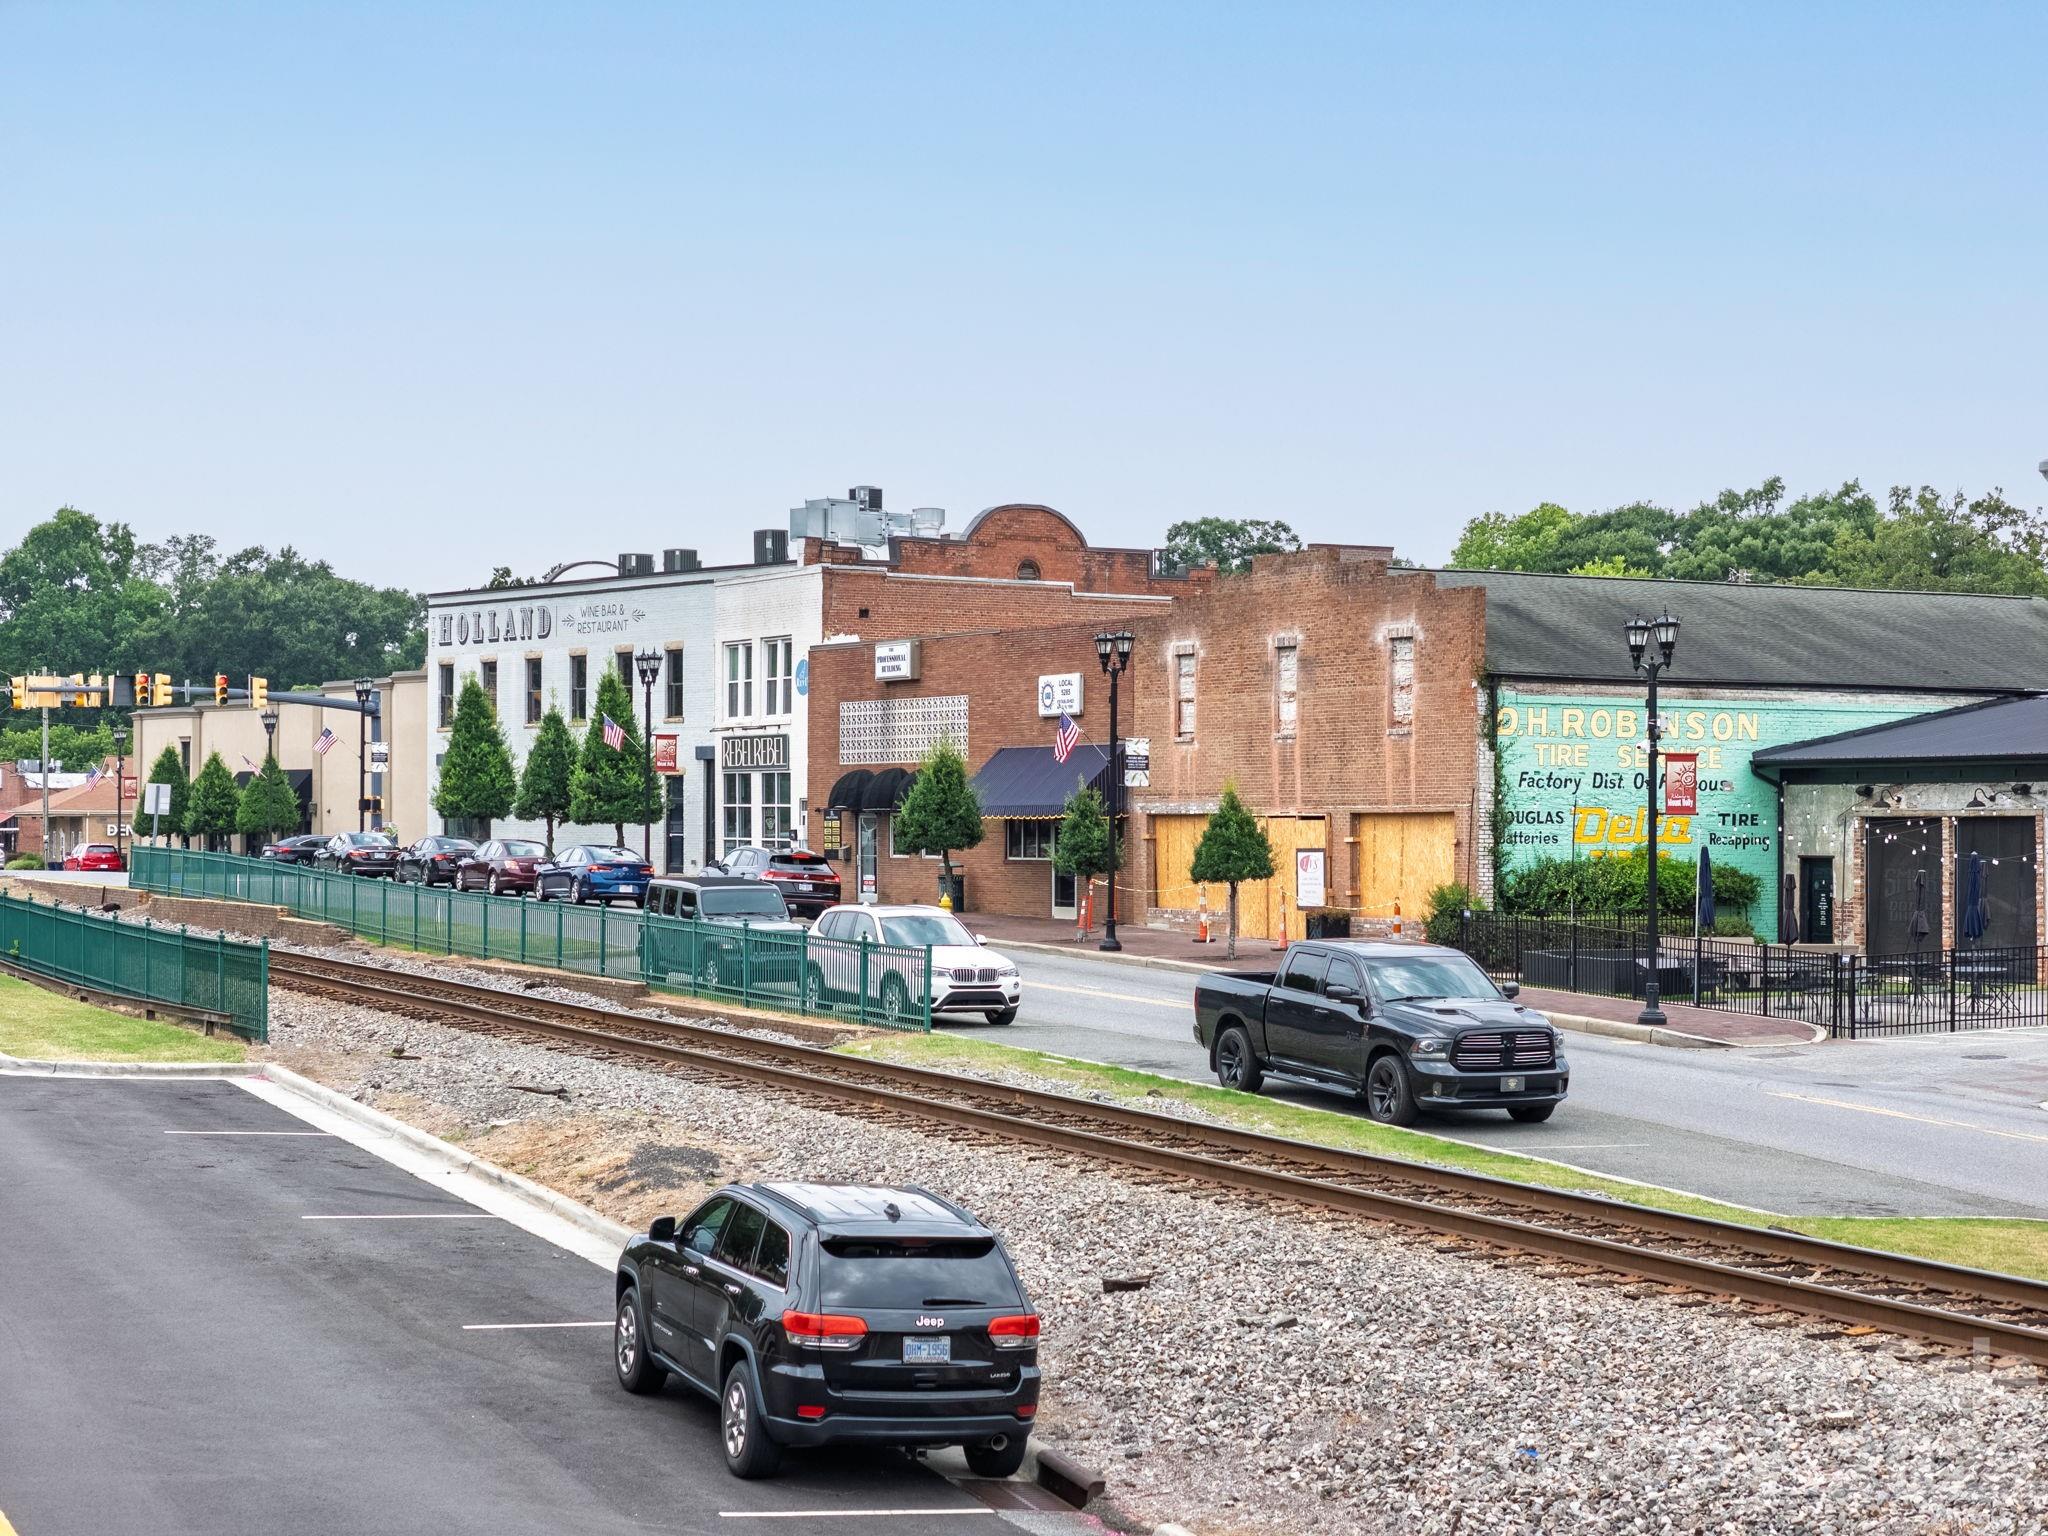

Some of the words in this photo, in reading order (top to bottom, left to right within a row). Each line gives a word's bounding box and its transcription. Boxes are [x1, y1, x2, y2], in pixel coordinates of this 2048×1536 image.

[580, 605, 600, 618] WINE
[601, 604, 617, 617] BAR
[619, 603, 624, 616] &
[438, 605, 552, 647] HOLLAND
[577, 619, 629, 634] RESTAURANT
[1058, 679, 1073, 687] LOCAL
[1562, 707, 1759, 742] ROBNSON
[723, 738, 754, 767] REBEL
[754, 737, 787, 766] REBEL
[1533, 743, 1590, 767] TIRE
[1617, 744, 1722, 769] SECE
[1518, 771, 1581, 795] Factory
[1592, 771, 1624, 789] Dist.
[1633, 772, 1650, 790] O
[1505, 811, 1564, 825] OUGLAS
[1717, 813, 1759, 826] TIRE
[1709, 832, 1770, 852] Recapping
[915, 1315, 945, 1328] Jeep
